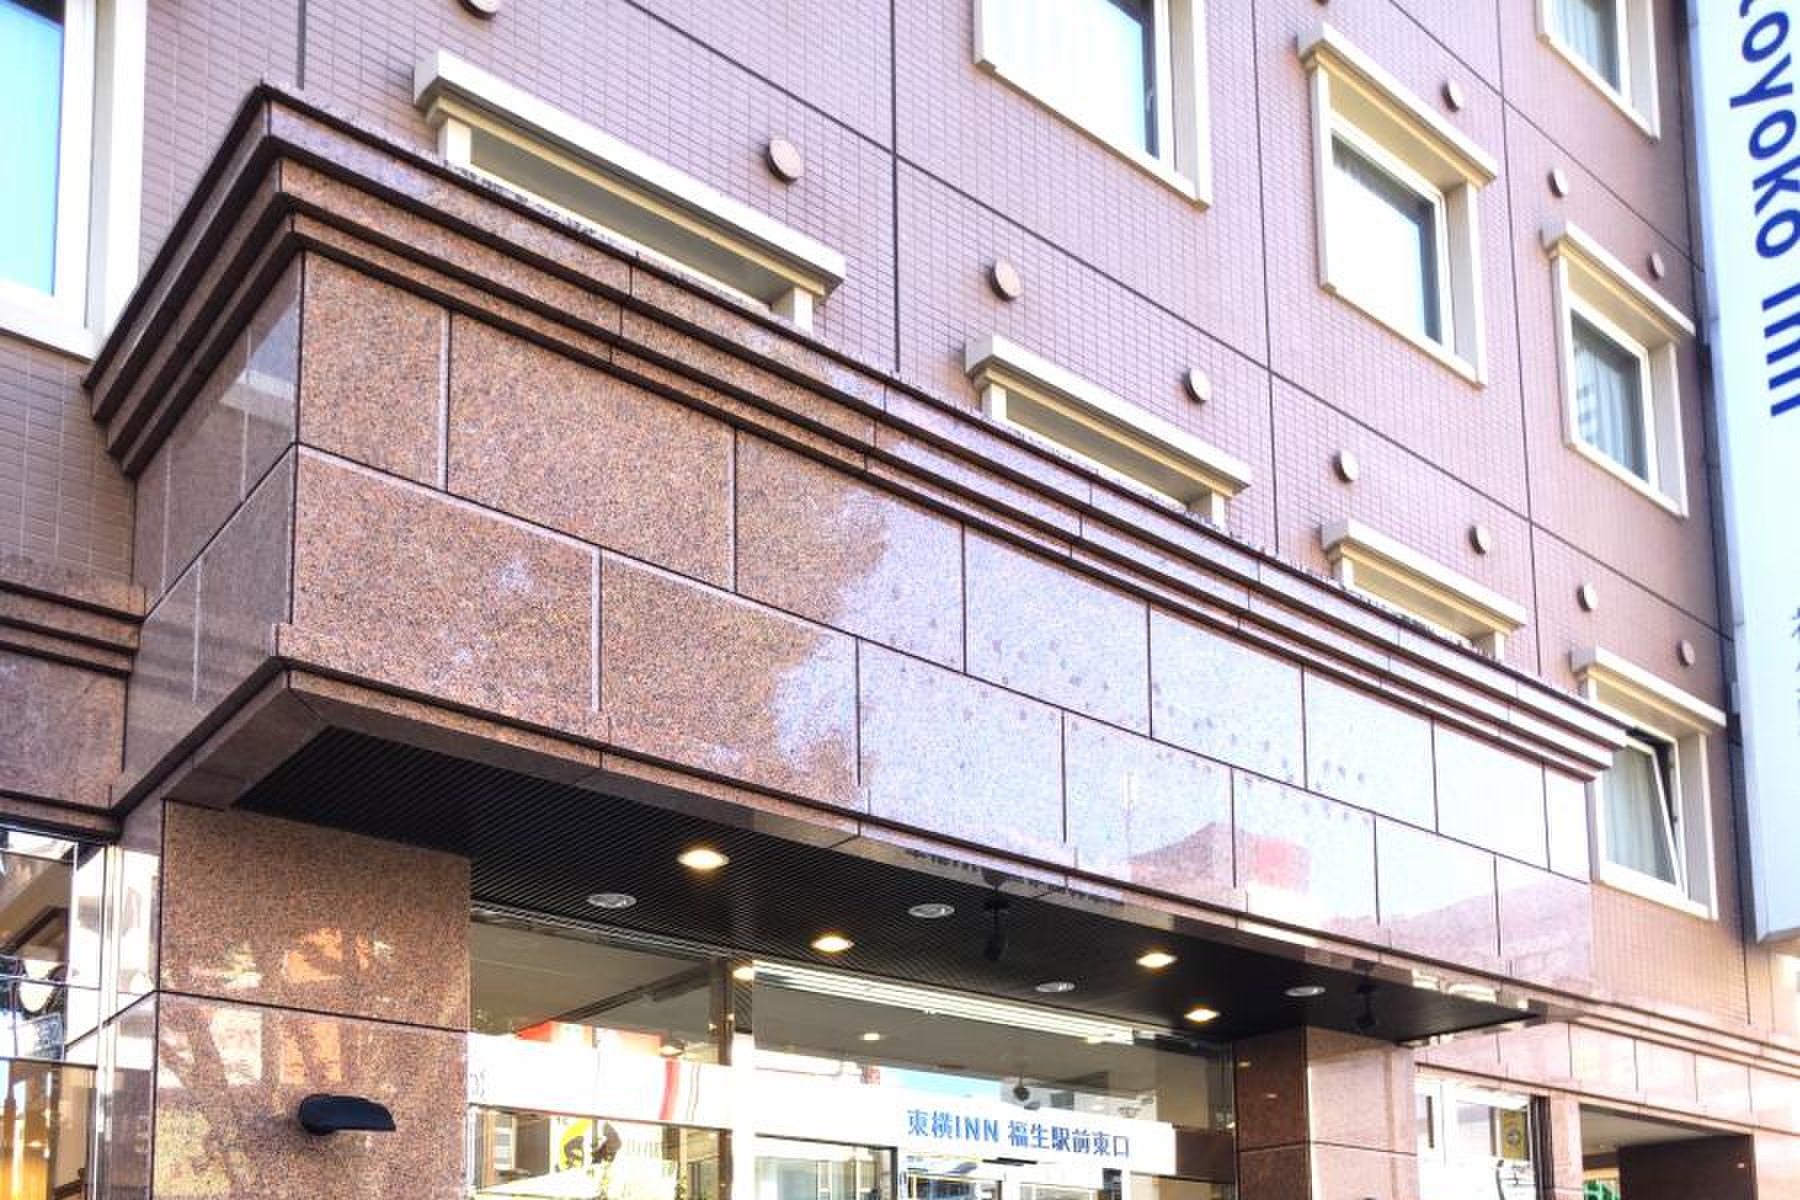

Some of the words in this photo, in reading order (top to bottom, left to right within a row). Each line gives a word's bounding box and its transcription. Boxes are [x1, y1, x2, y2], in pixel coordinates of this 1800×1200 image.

[1007, 1120, 1130, 1157] 福生駅前東口
